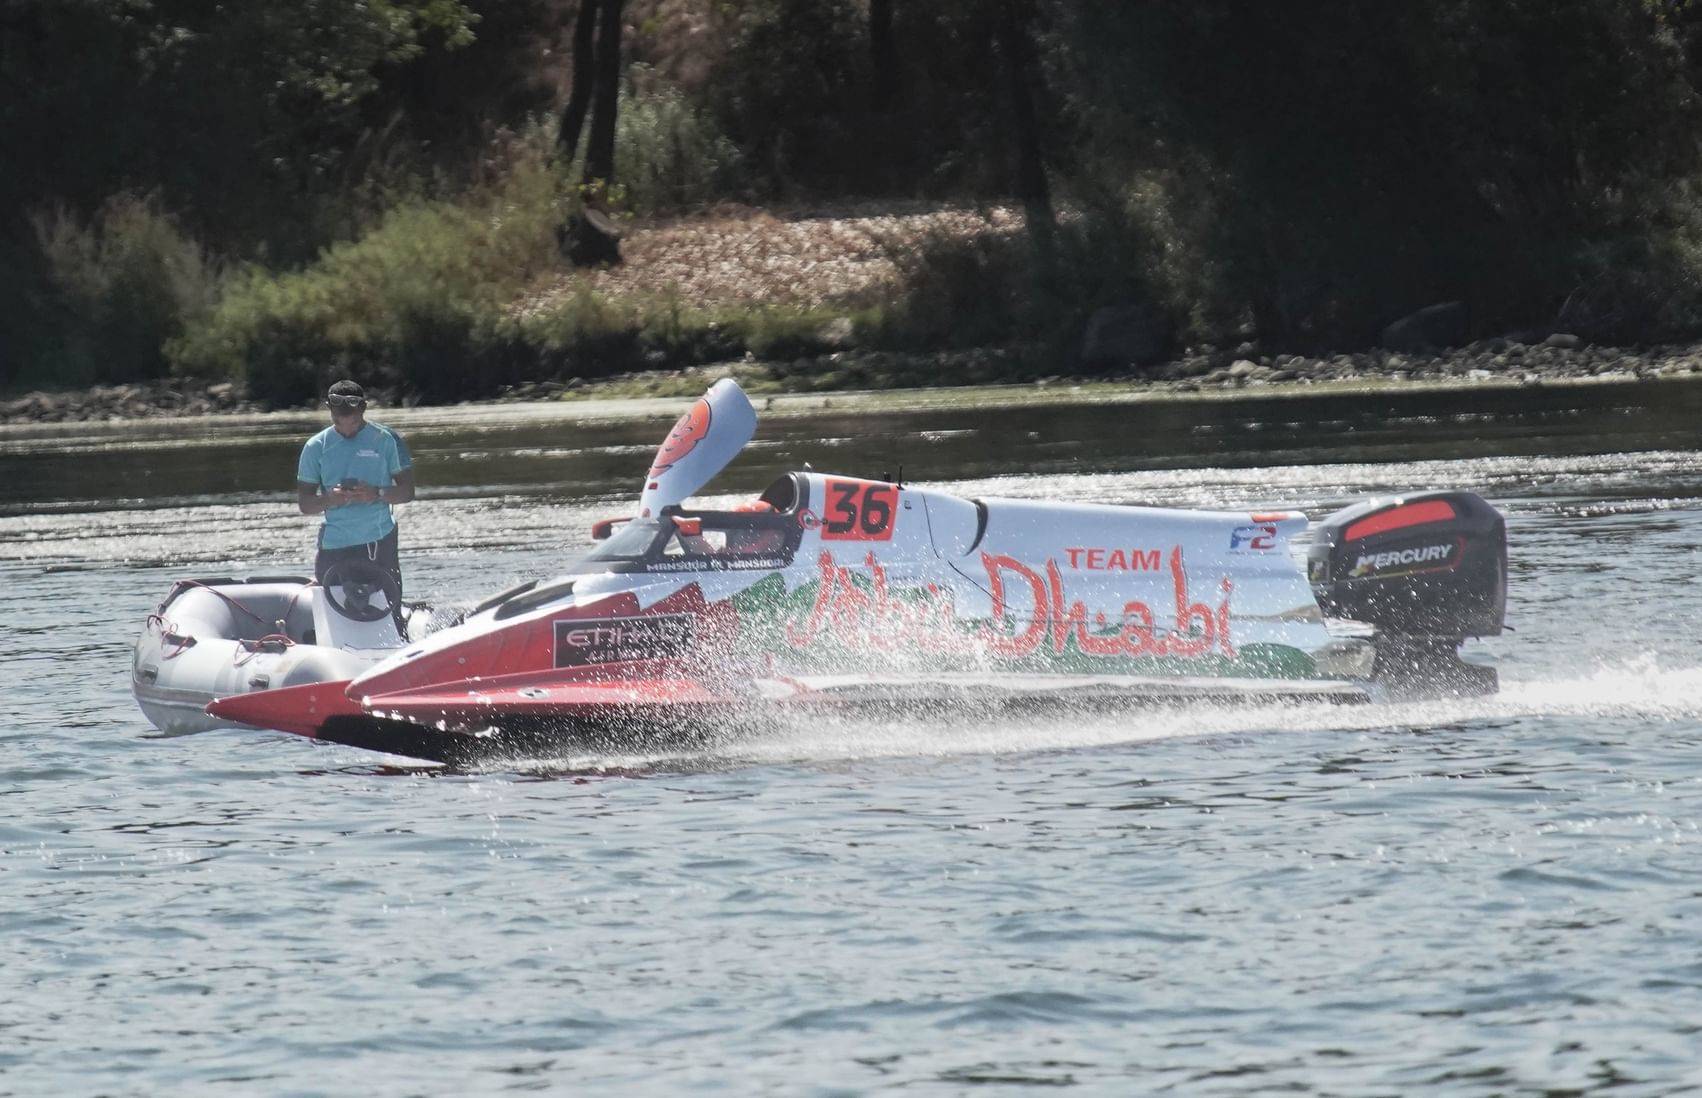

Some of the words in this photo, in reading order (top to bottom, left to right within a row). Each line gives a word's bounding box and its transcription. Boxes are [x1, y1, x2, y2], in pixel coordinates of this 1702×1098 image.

[828, 483, 891, 535] 36
[1230, 526, 1277, 549] F2
[1065, 548, 1161, 571] TEAM
[1355, 544, 1452, 569] MERCURY
[981, 544, 1237, 657] Dhabi
